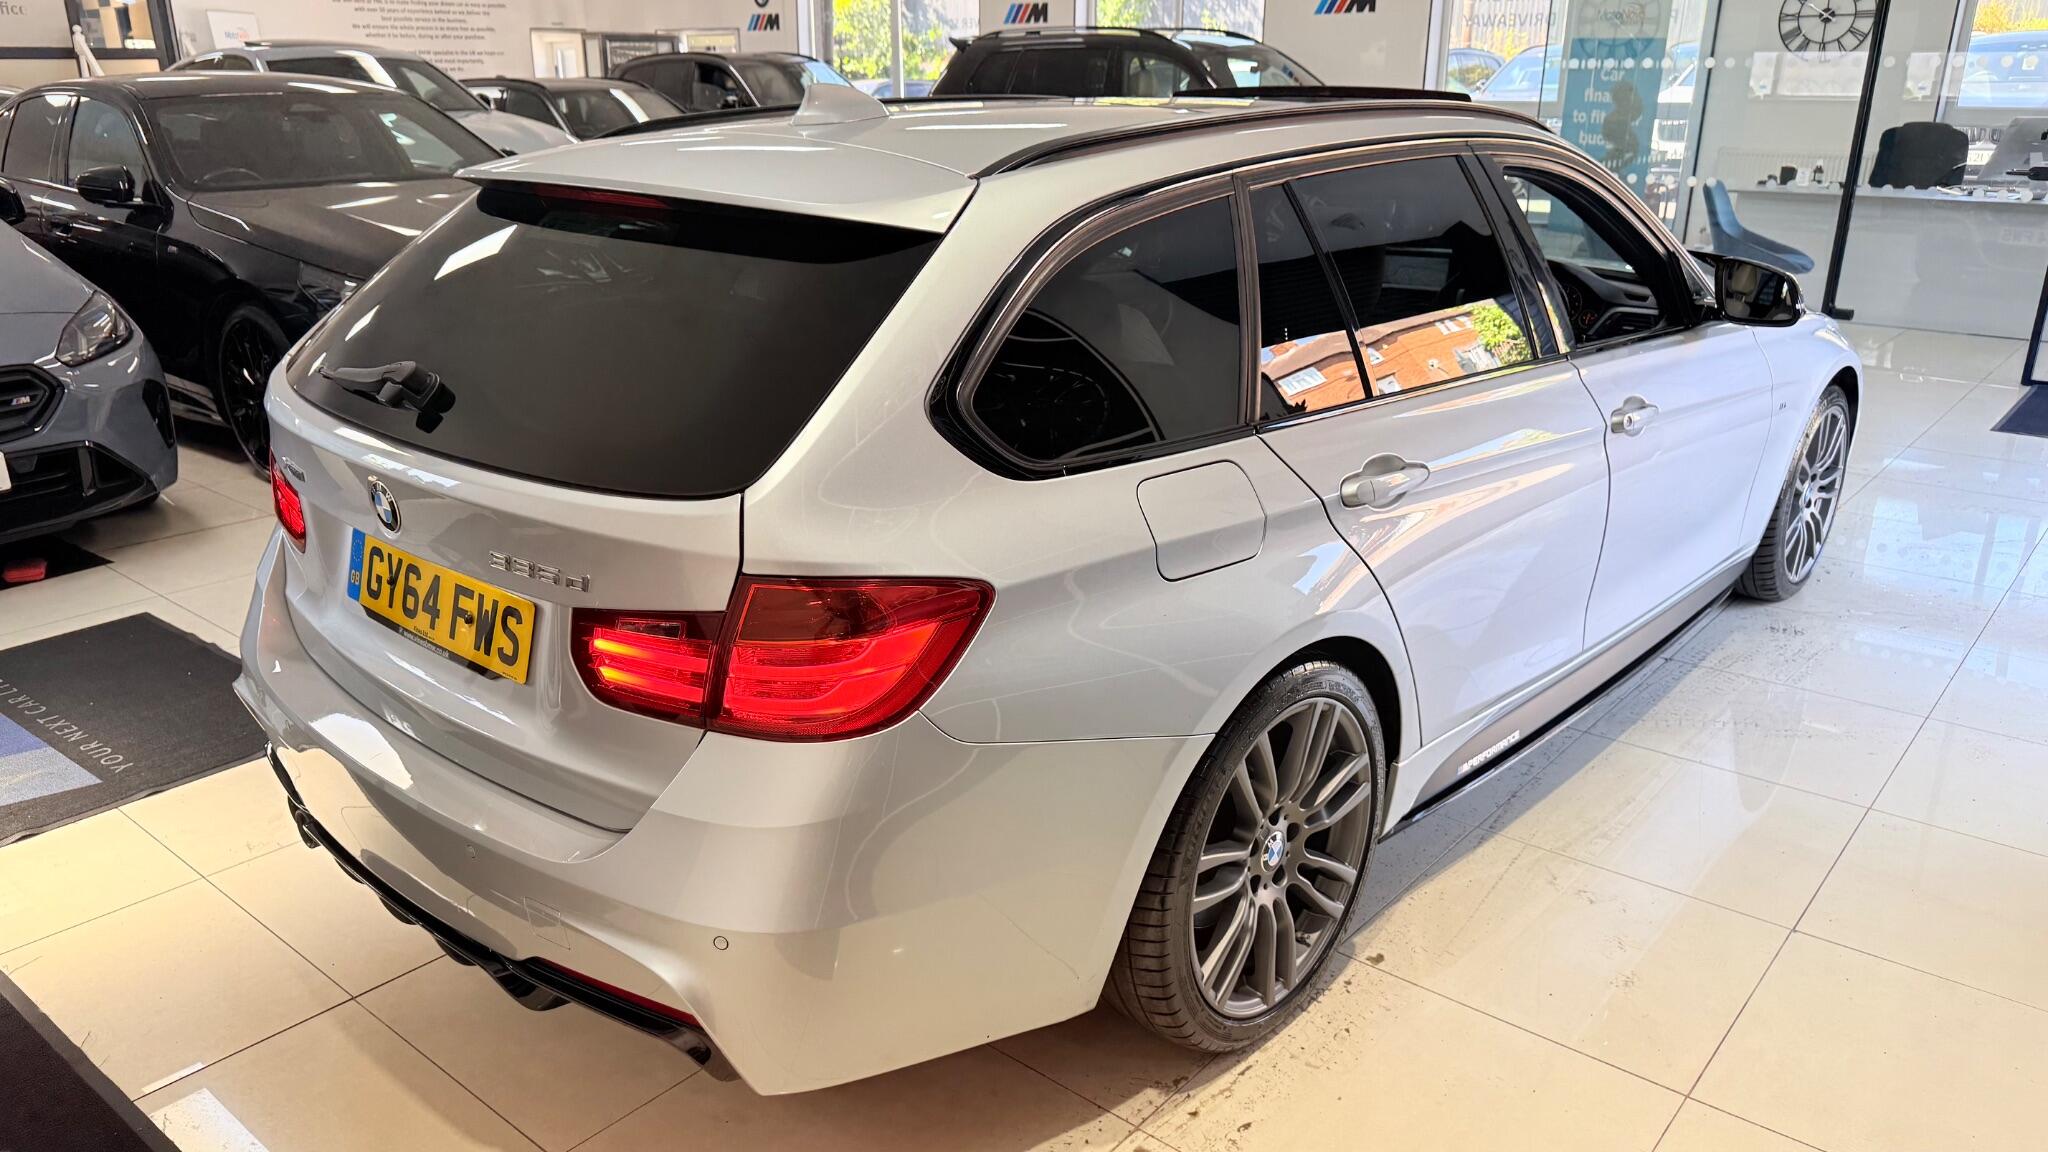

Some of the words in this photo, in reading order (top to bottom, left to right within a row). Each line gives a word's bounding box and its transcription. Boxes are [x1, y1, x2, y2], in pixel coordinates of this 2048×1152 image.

[1573, 109, 1586, 124] to
[350, 570, 360, 585] GB
[366, 545, 441, 631] GY64
[449, 583, 523, 667] FWS
[8, 694, 47, 715] CAR
[36, 715, 89, 742] NEXT
[80, 740, 134, 773] YOUR
